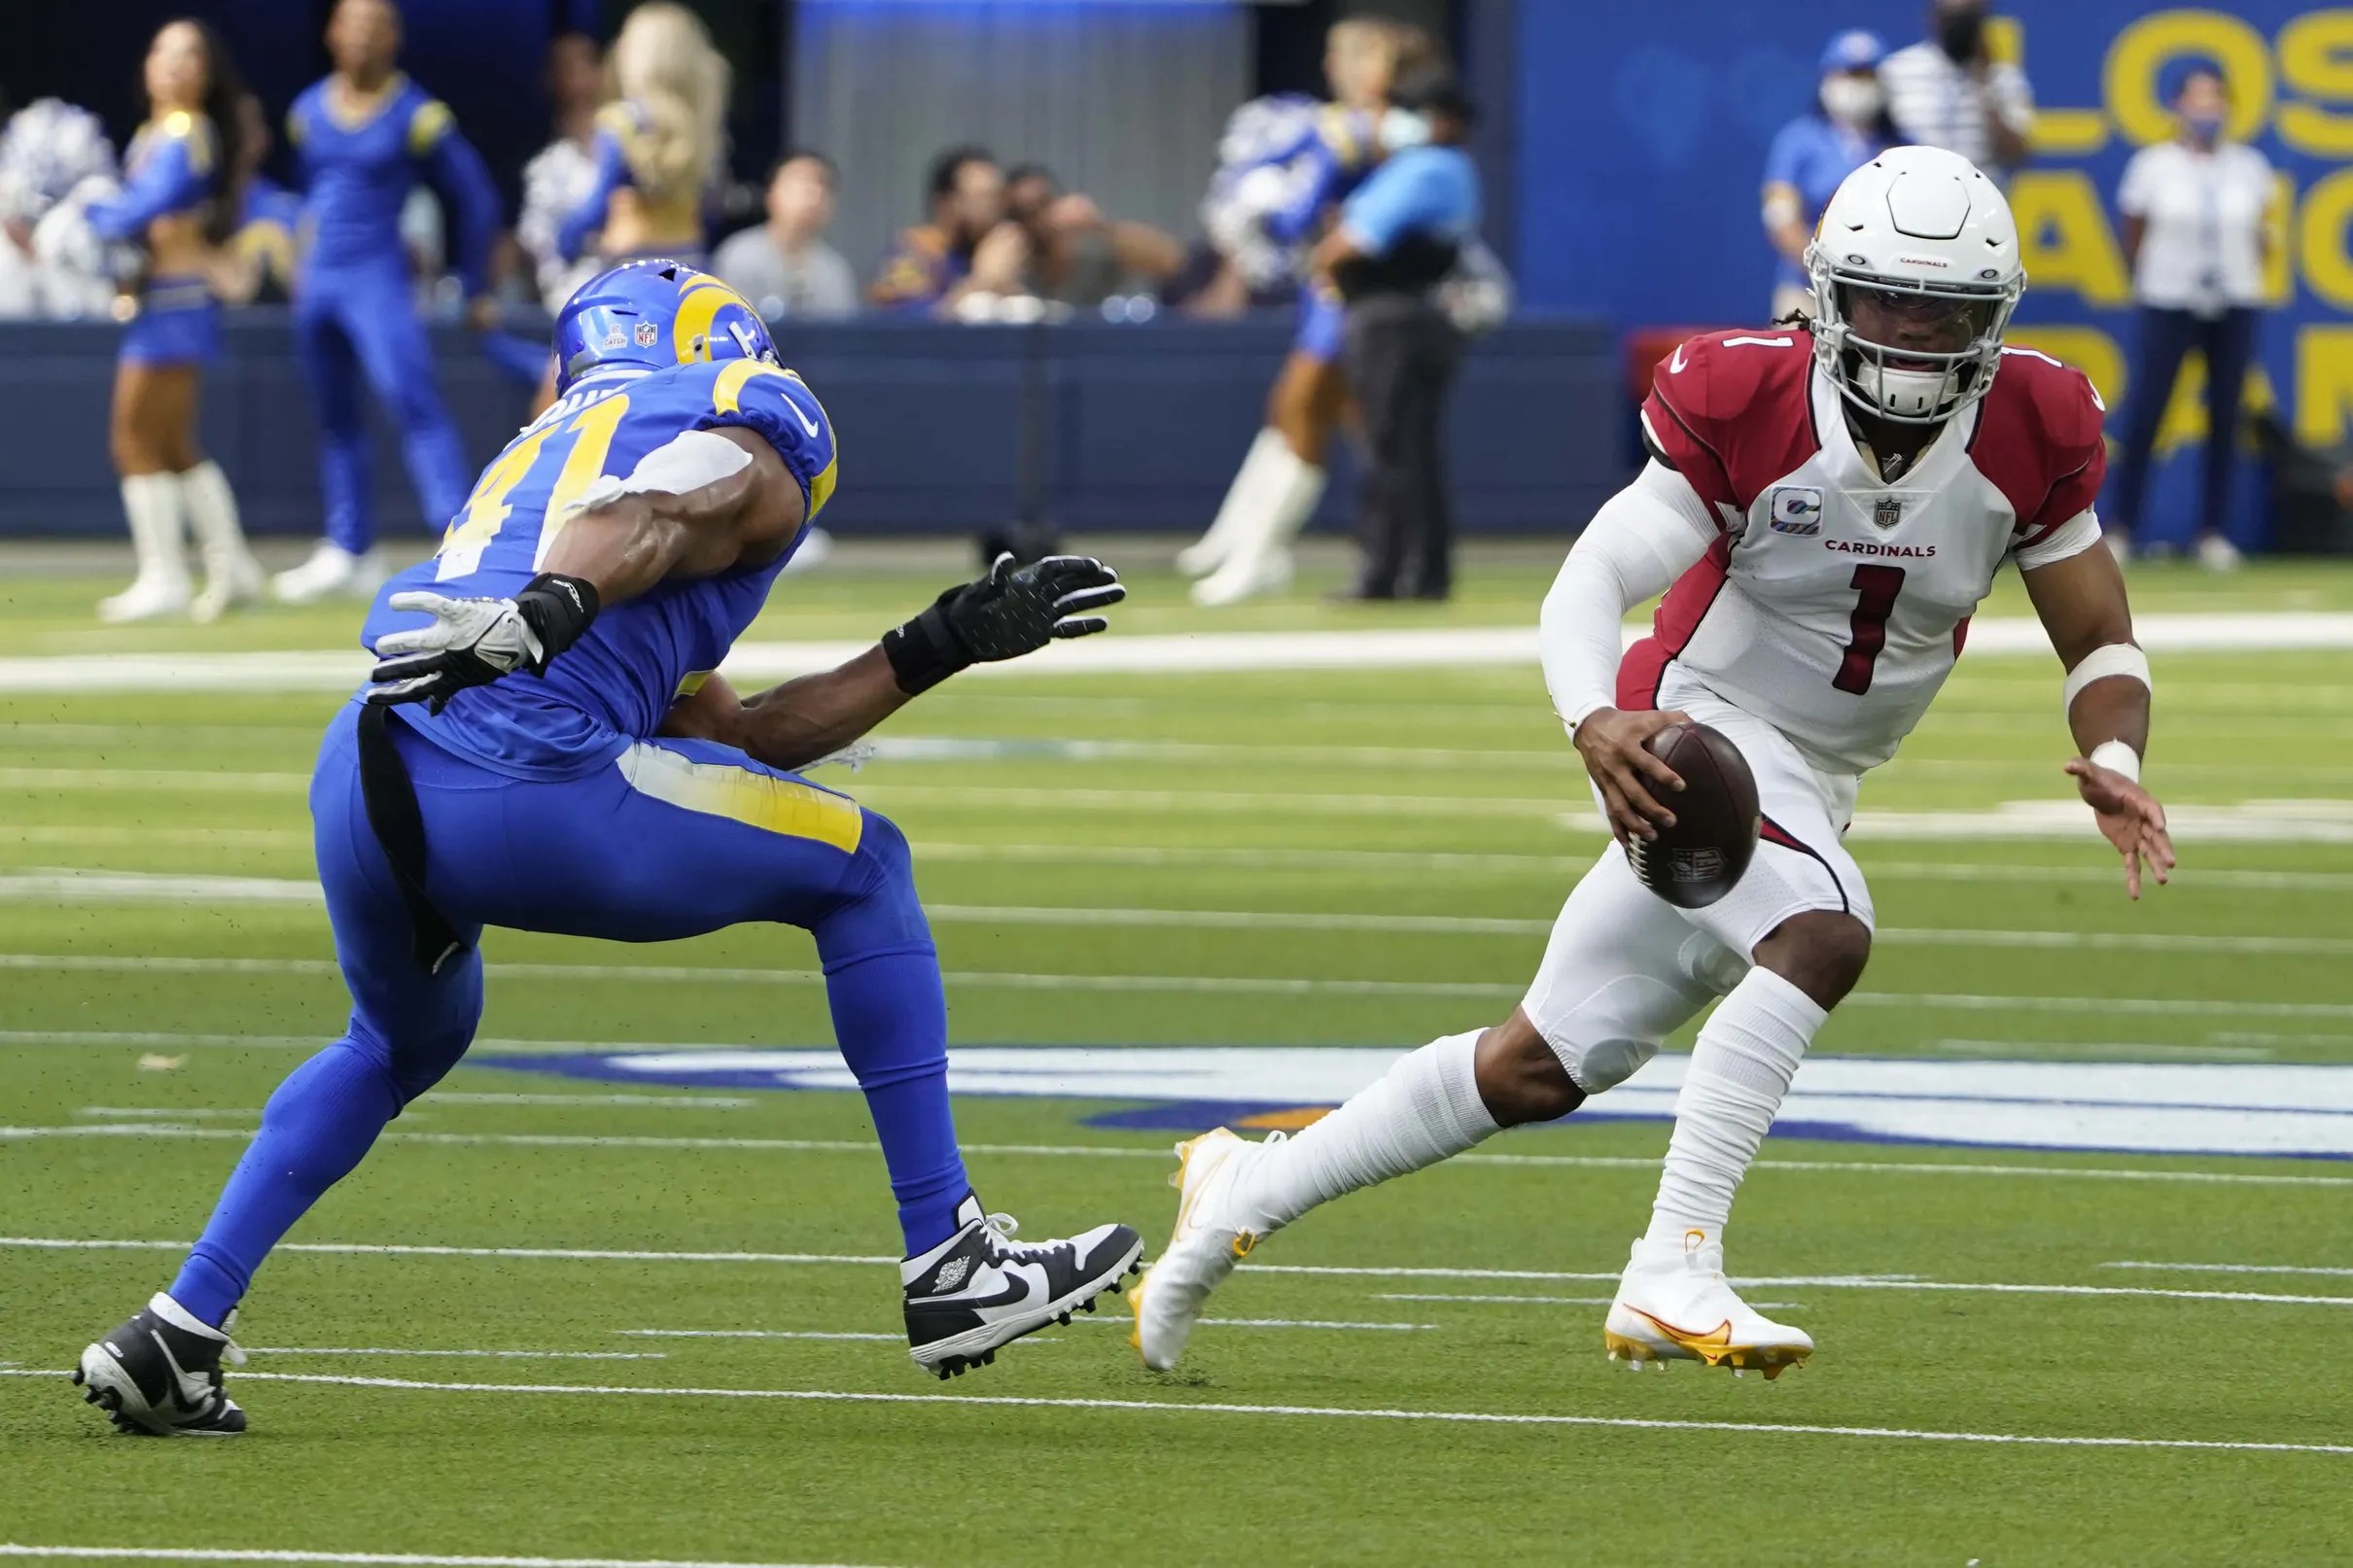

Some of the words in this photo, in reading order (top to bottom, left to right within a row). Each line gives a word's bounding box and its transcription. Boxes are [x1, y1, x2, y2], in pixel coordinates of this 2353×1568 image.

[1900, 257, 1948, 268] CARDINALS
[434, 393, 631, 582] 41
[1824, 539, 1937, 558] CARDINALS
[1832, 563, 1907, 696] 1
